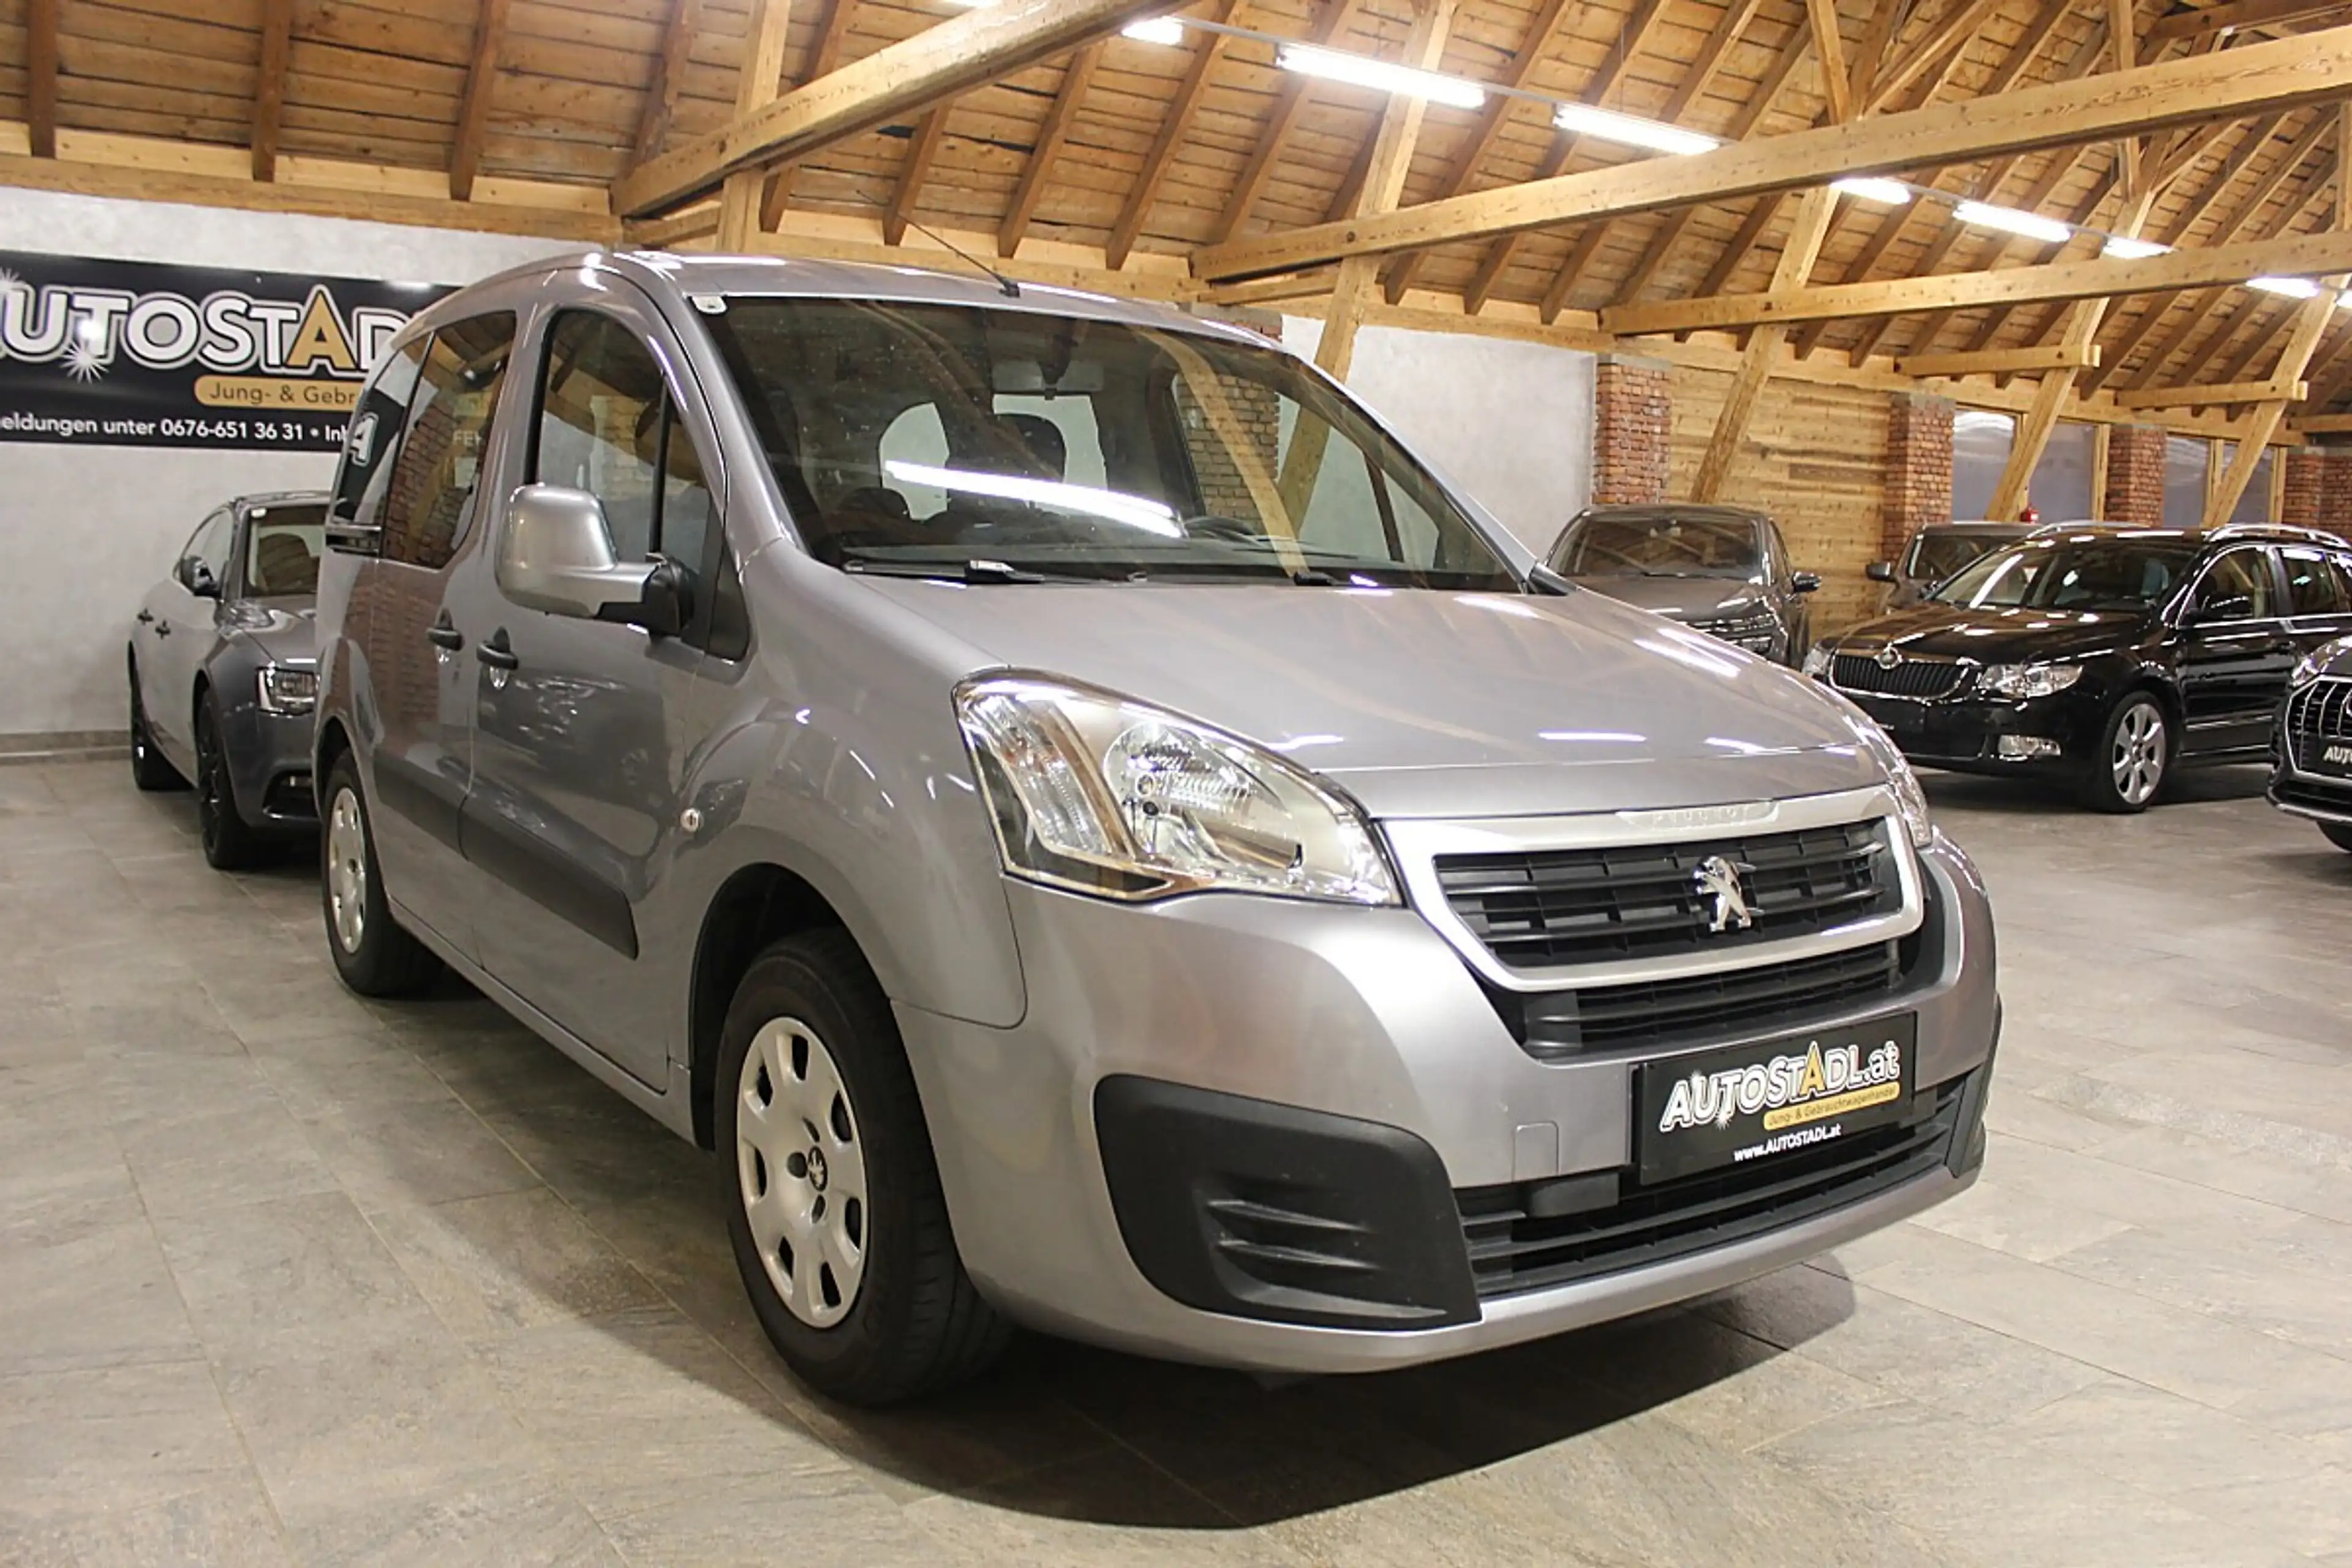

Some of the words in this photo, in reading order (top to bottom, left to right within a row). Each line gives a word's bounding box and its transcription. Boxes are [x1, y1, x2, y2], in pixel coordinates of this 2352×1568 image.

[0, 285, 408, 371] UTOSTAD
[209, 382, 271, 404] Jung-
[280, 388, 295, 402] &
[104, 419, 156, 435] unter
[160, 418, 247, 439] 0676-651
[254, 422, 277, 439] 36
[282, 423, 303, 440] 31
[2323, 745, 2352, 765] AUT
[1660, 1041, 1900, 1132] AUTOSTADL.at
[1733, 1123, 1842, 1162] www.AUTOSTADL.at
